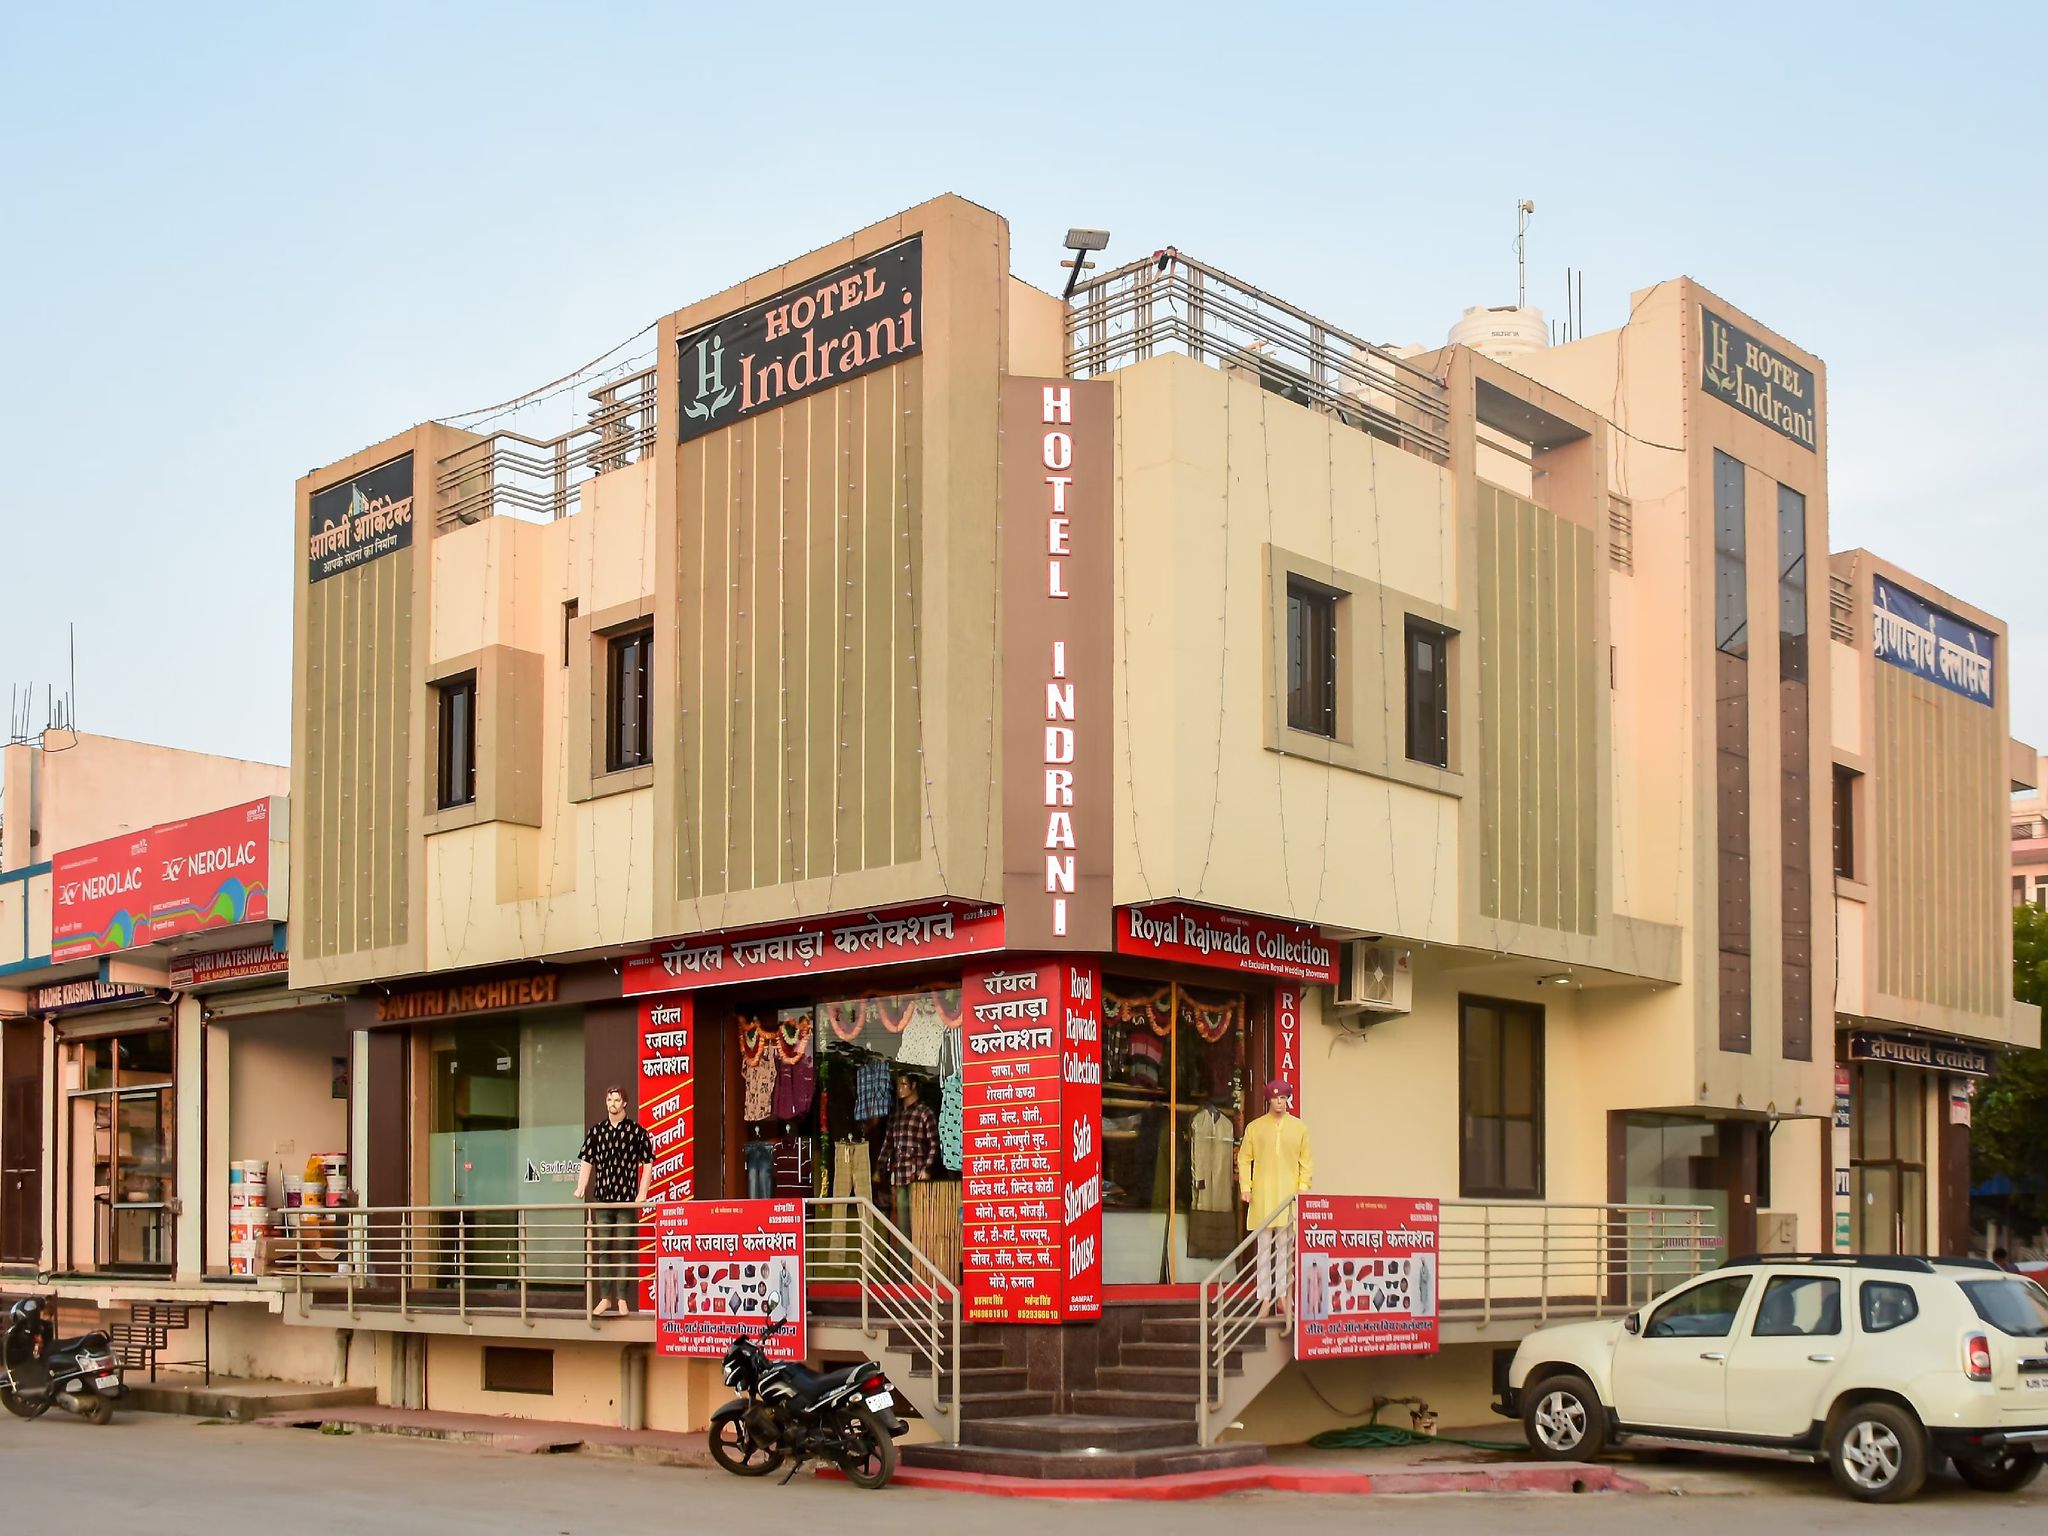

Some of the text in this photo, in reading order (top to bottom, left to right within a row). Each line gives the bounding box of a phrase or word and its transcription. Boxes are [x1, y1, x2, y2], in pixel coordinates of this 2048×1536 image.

[765, 267, 886, 342] HOTEL
[738, 292, 916, 412] Indrani
[1745, 342, 1803, 398] HOTEL
[1736, 364, 1815, 446] Indrani
[309, 514, 351, 561] सावित्री
[323, 553, 344, 573] आपके
[363, 544, 374, 559] का
[375, 533, 398, 553] निर्माण
[1041, 384, 1077, 937] HOTEL INDRANI
[188, 840, 256, 878] NEROLAC
[82, 866, 142, 902] NEROLAC
[662, 911, 954, 977] रॉयल रजवाड़ा कलेक्शन
[1130, 908, 1330, 967] Royal Rajwada Collection
[194, 953, 215, 973] SHRI
[212, 969, 231, 980] NAGAR
[231, 967, 250, 977] PALIKA
[1240, 959, 1329, 980] An Exclusive Royal Wedding Showroom
[39, 986, 62, 1009] RADHE
[62, 980, 95, 1005] KRISHNA
[95, 979, 115, 999] TILES
[376, 975, 557, 1021] SAVITRI ARCHITECT
[984, 970, 1037, 995] रॉयल
[1071, 967, 1092, 1006] Royal
[651, 1004, 681, 1026] रॉयल
[973, 998, 1048, 1023] रजवाड़ा
[1066, 1008, 1097, 1047] Rajwada
[645, 1030, 688, 1052] रजवाड़ा
[969, 1024, 1053, 1054] कलेक्शन
[642, 1052, 690, 1078] कलेक्शन
[1015, 1063, 1030, 1075] पाग
[1063, 1051, 1100, 1085] Collection
[652, 1094, 680, 1121] साफा
[986, 1084, 1014, 1101] शेरवानी
[1073, 1113, 1092, 1163] Safa
[540, 1160, 566, 1174] Savitri
[1064, 1162, 1100, 1226] Sherwani
[661, 1226, 797, 1257] रॉयल रजवाड़ा कलेक्शन
[1304, 1222, 1435, 1253] रॉयल रजवाड़ा कलेक्शन
[1069, 1234, 1095, 1280] House
